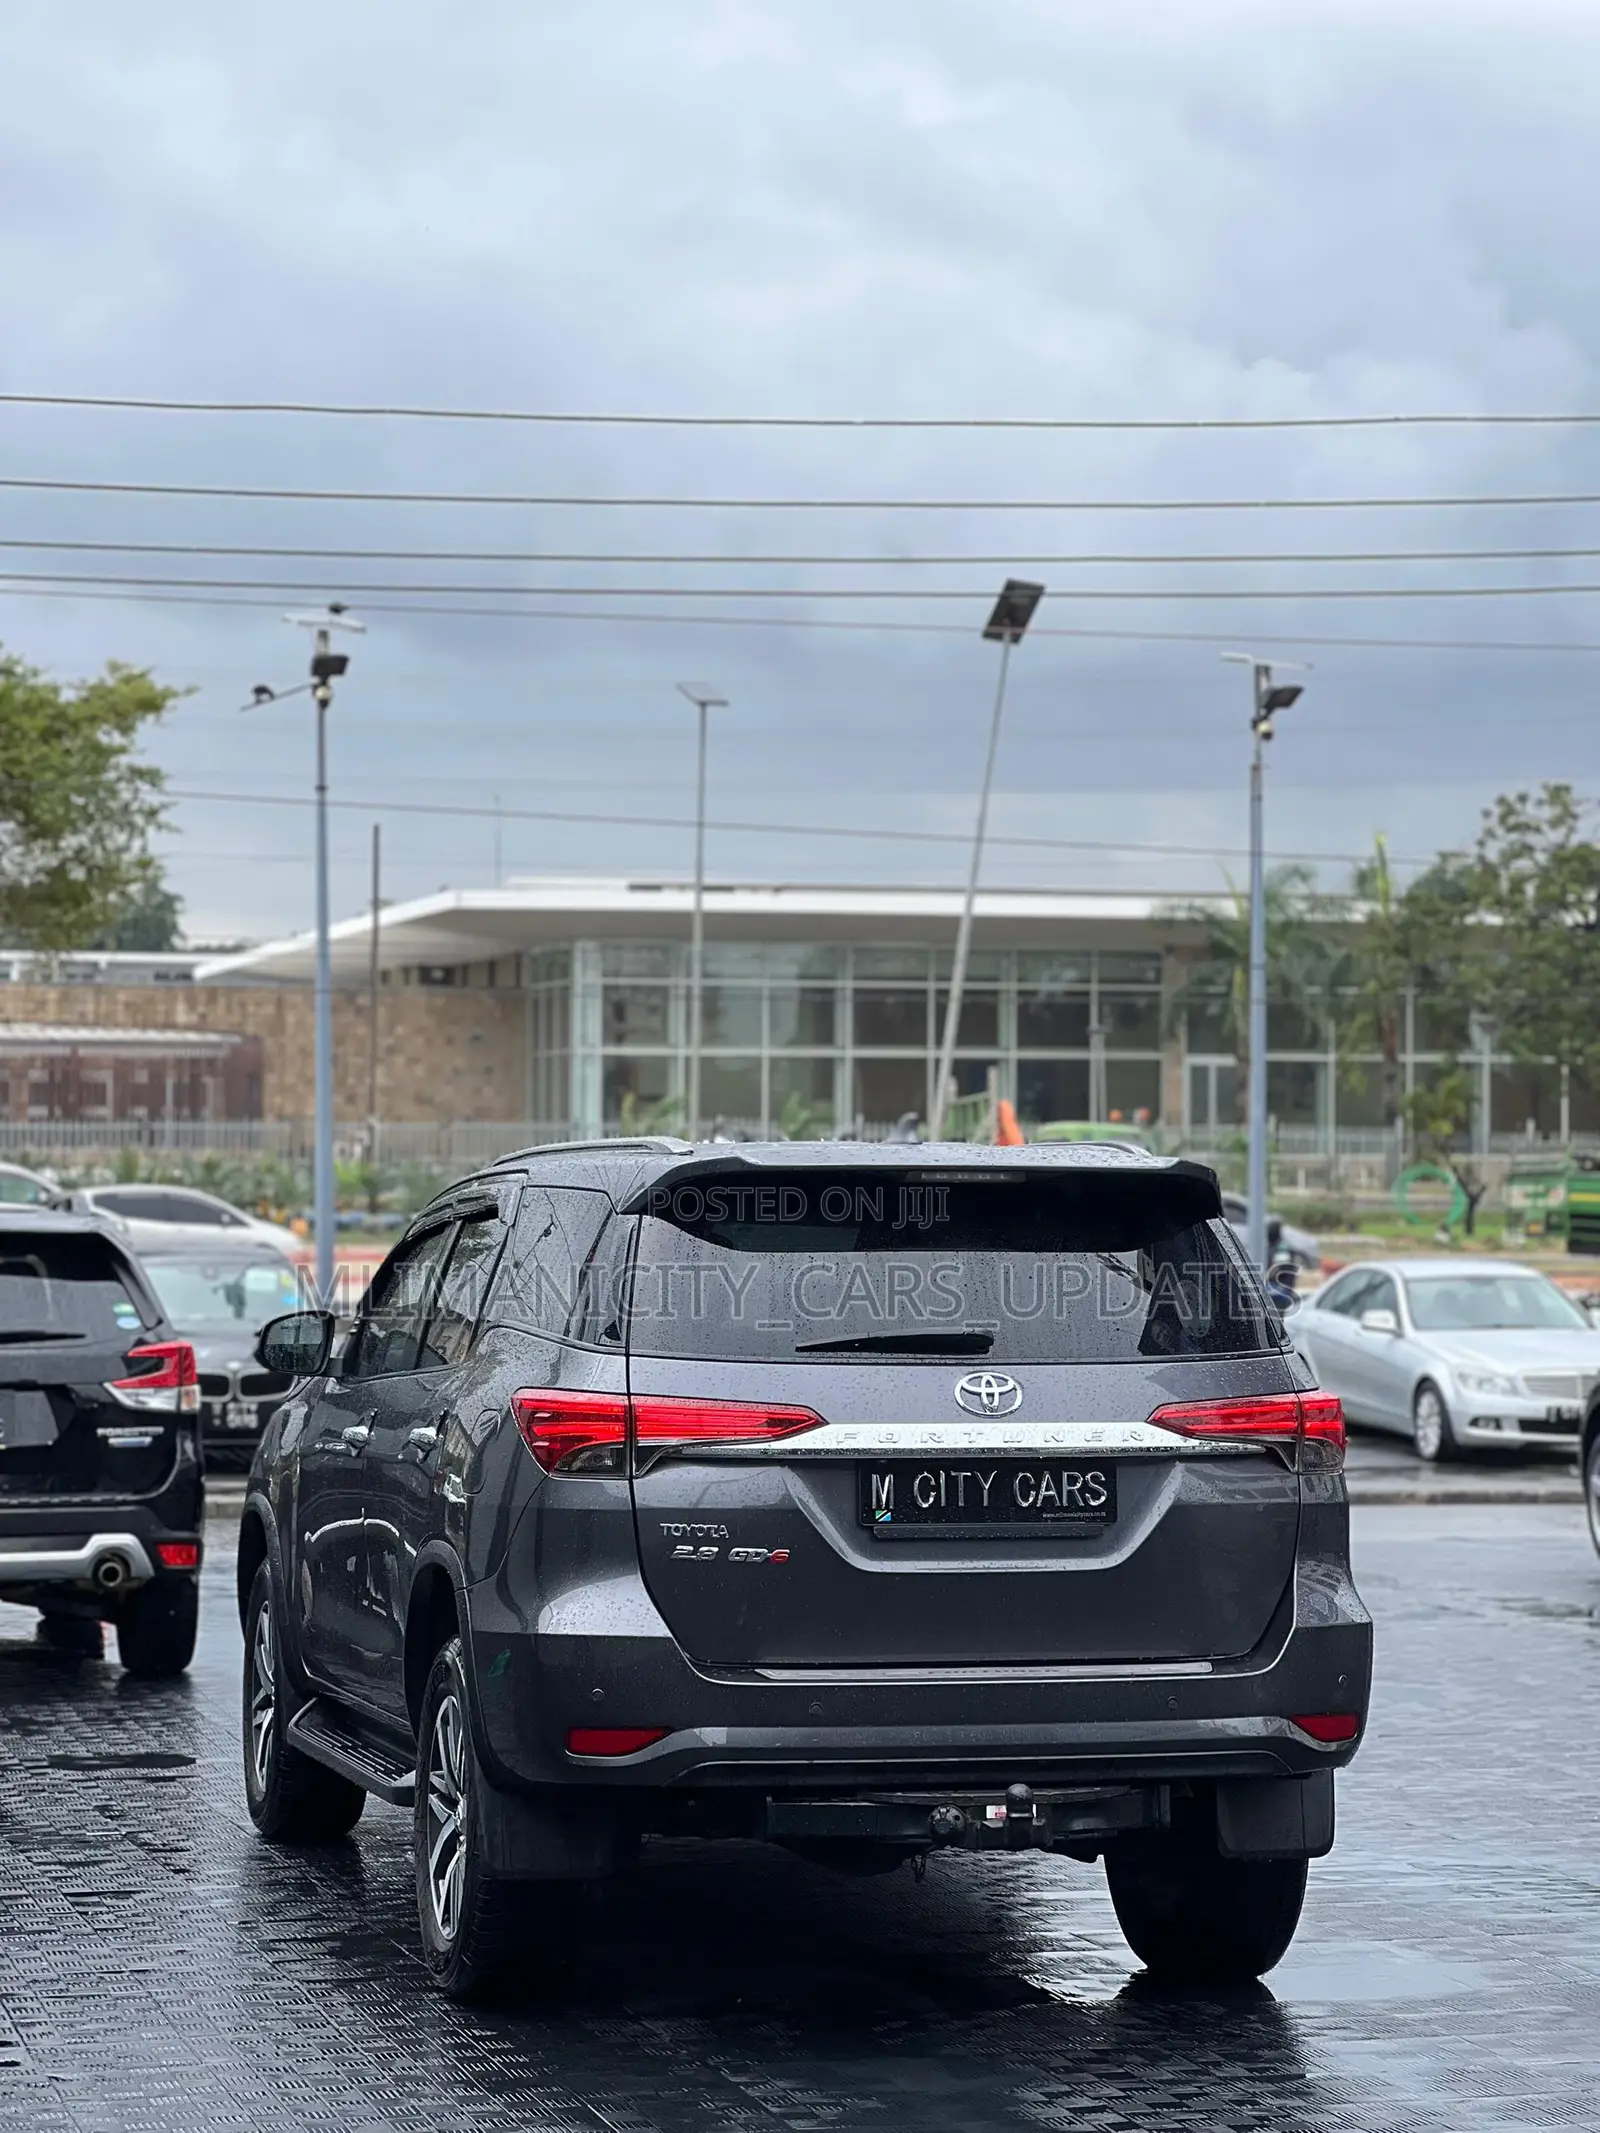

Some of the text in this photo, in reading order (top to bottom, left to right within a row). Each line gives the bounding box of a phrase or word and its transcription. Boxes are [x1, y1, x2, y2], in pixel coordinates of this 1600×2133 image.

[835, 1430, 1146, 1444] FORTUNER
[871, 1470, 1107, 1509] M CITY CARS
[659, 1523, 729, 1538] TOYOTA
[727, 1547, 791, 1564] GD-6
